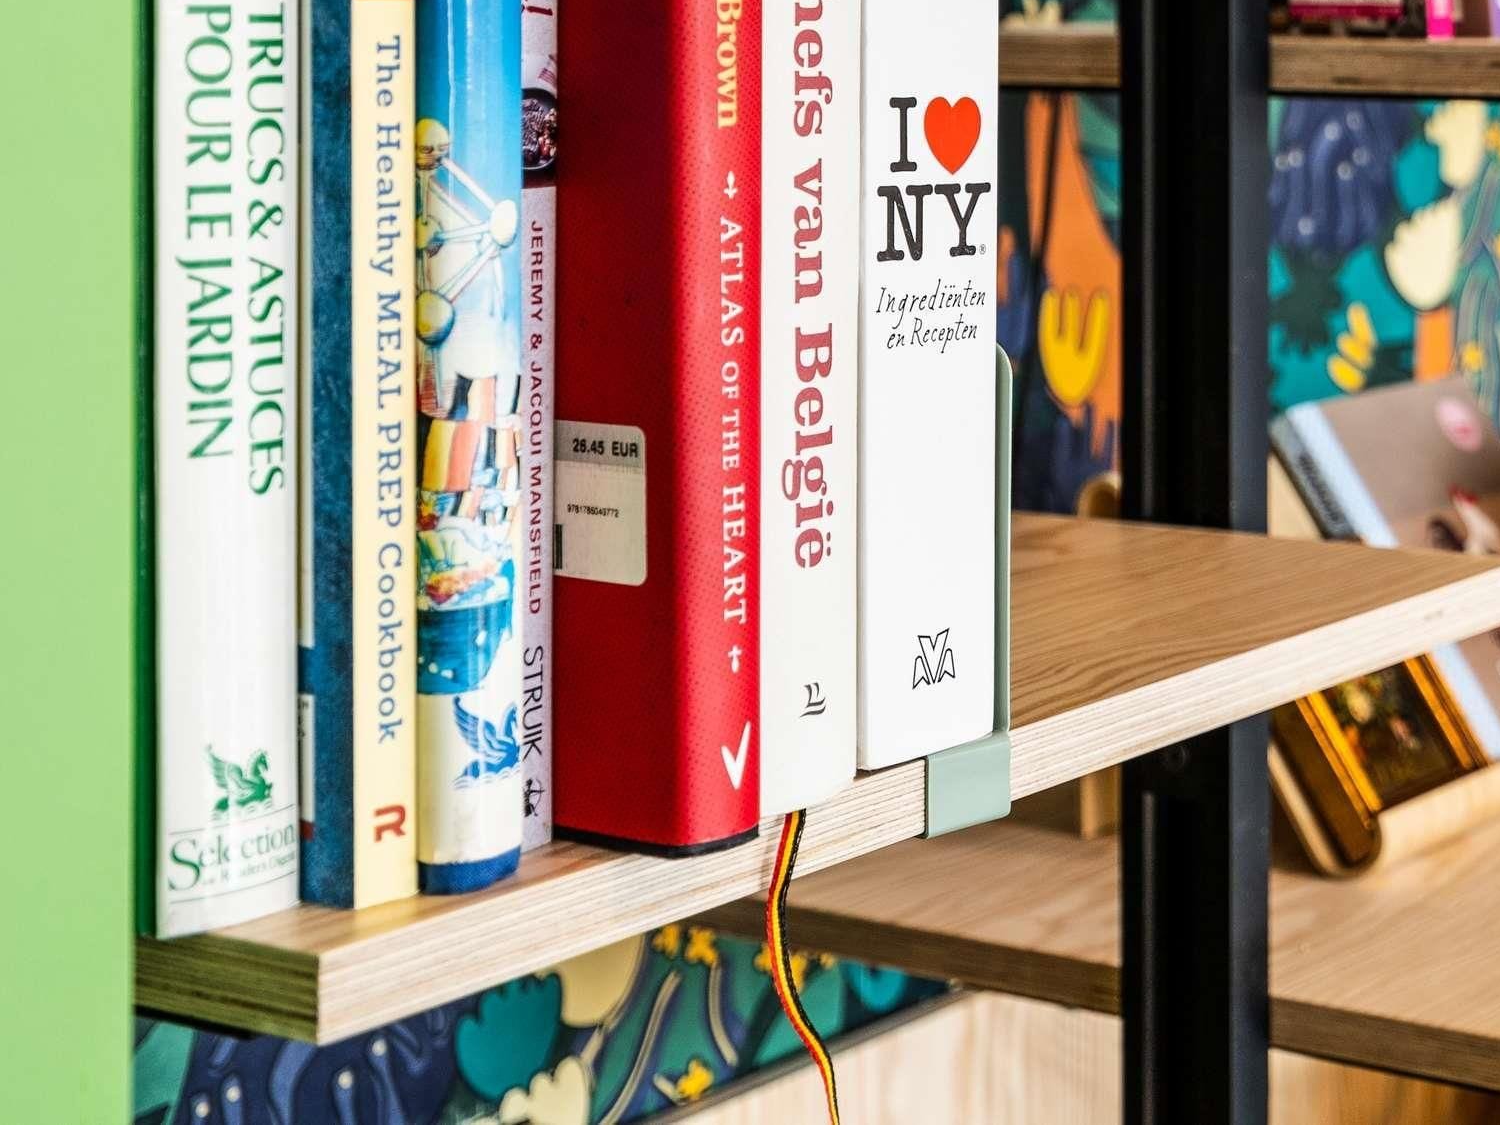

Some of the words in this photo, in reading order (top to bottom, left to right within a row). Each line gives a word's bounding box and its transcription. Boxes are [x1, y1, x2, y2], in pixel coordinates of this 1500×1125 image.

[185, 5, 232, 166] POUR
[247, 3, 285, 186] TRUCS
[377, 35, 400, 107] The
[889, 97, 917, 173] I
[186, 185, 232, 239] LE
[247, 200, 285, 239] &
[370, 123, 401, 277] Healthy
[793, 158, 823, 304] van
[529, 220, 544, 323] JEREMY
[720, 217, 745, 347] ATLAS
[875, 278, 987, 330] Ingrediënten
[176, 258, 232, 460] JARDIN
[247, 257, 286, 496] ASTUCES
[377, 289, 402, 410] MEAL
[528, 332, 544, 350] &
[720, 360, 741, 400] OF
[886, 332, 906, 350] en
[910, 313, 978, 354] Recepten
[528, 362, 543, 458] JACQUI
[611, 440, 639, 458] EUR
[720, 408, 742, 472] THE
[782, 323, 833, 568] België
[377, 421, 403, 528] PREP
[528, 465, 542, 615] MANSFIELD
[721, 484, 747, 625] HEART
[377, 542, 403, 745] Cookbook
[521, 645, 543, 763] STRUIK
